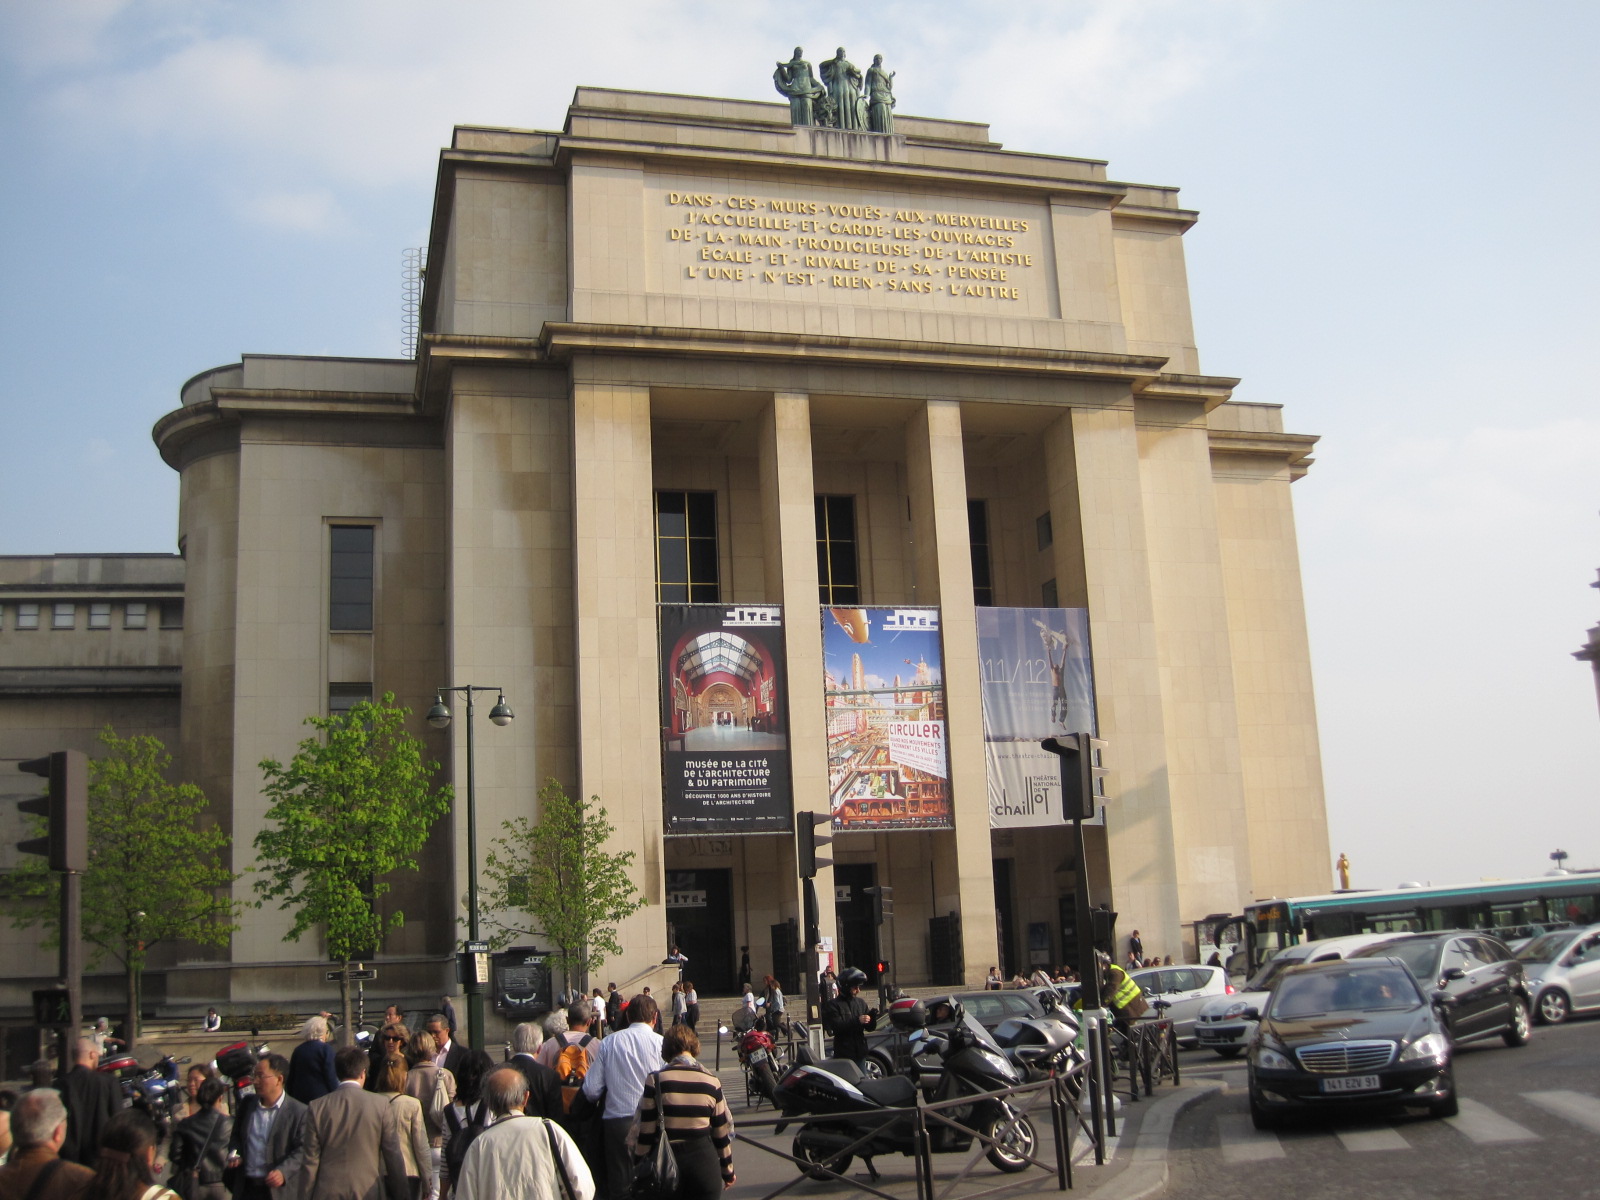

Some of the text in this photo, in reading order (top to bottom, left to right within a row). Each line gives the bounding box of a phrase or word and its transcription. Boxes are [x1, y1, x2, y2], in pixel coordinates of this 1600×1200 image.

[669, 192, 714, 207] DANS
[726, 196, 758, 211] CES
[770, 200, 818, 215] MURS
[894, 210, 925, 224] AUX
[935, 213, 1030, 233] MERVEILLES
[800, 220, 820, 233] ET
[829, 221, 884, 238] GARDE
[893, 227, 921, 241] LES
[930, 229, 1015, 248] OUVRAGES
[670, 228, 1033, 267] DE LA MAIN PRODIGIEUSE DE L'ARTISTE
[769, 252, 789, 266] ET
[805, 254, 860, 271] RIVALE
[875, 260, 897, 273] DE
[911, 263, 932, 276] SA
[832, 274, 874, 290] RIEN
[887, 278, 933, 294] SANS
[949, 283, 1020, 300] L'AUTRE
[921, 748, 939, 756] VILLES
[697, 779, 709, 787] DU
[1326, 1076, 1378, 1089] 141 EZV 91
